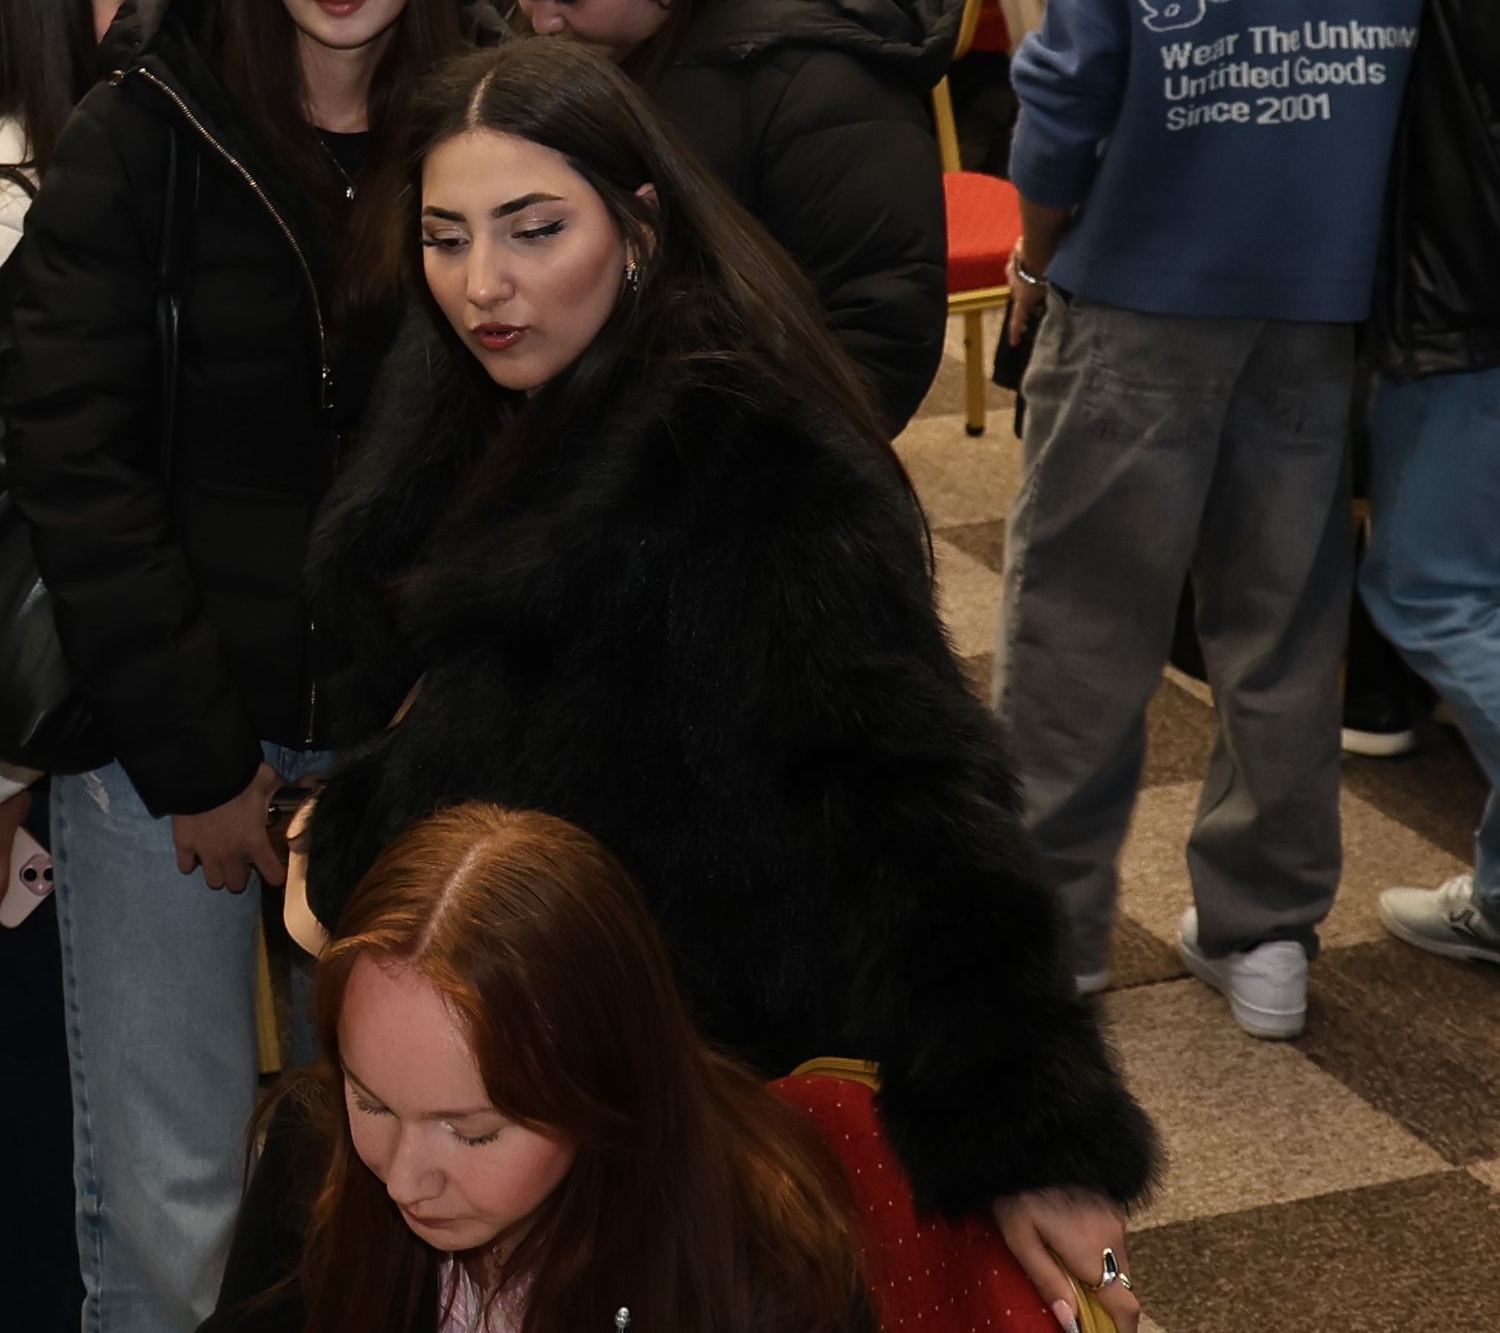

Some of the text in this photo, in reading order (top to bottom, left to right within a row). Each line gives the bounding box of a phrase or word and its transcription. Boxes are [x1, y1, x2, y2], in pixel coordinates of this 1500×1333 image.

[1160, 19, 1419, 72] Wear The Unknow
[1163, 56, 1386, 101] Untitled Goods
[1166, 93, 1331, 131] Since 2001
